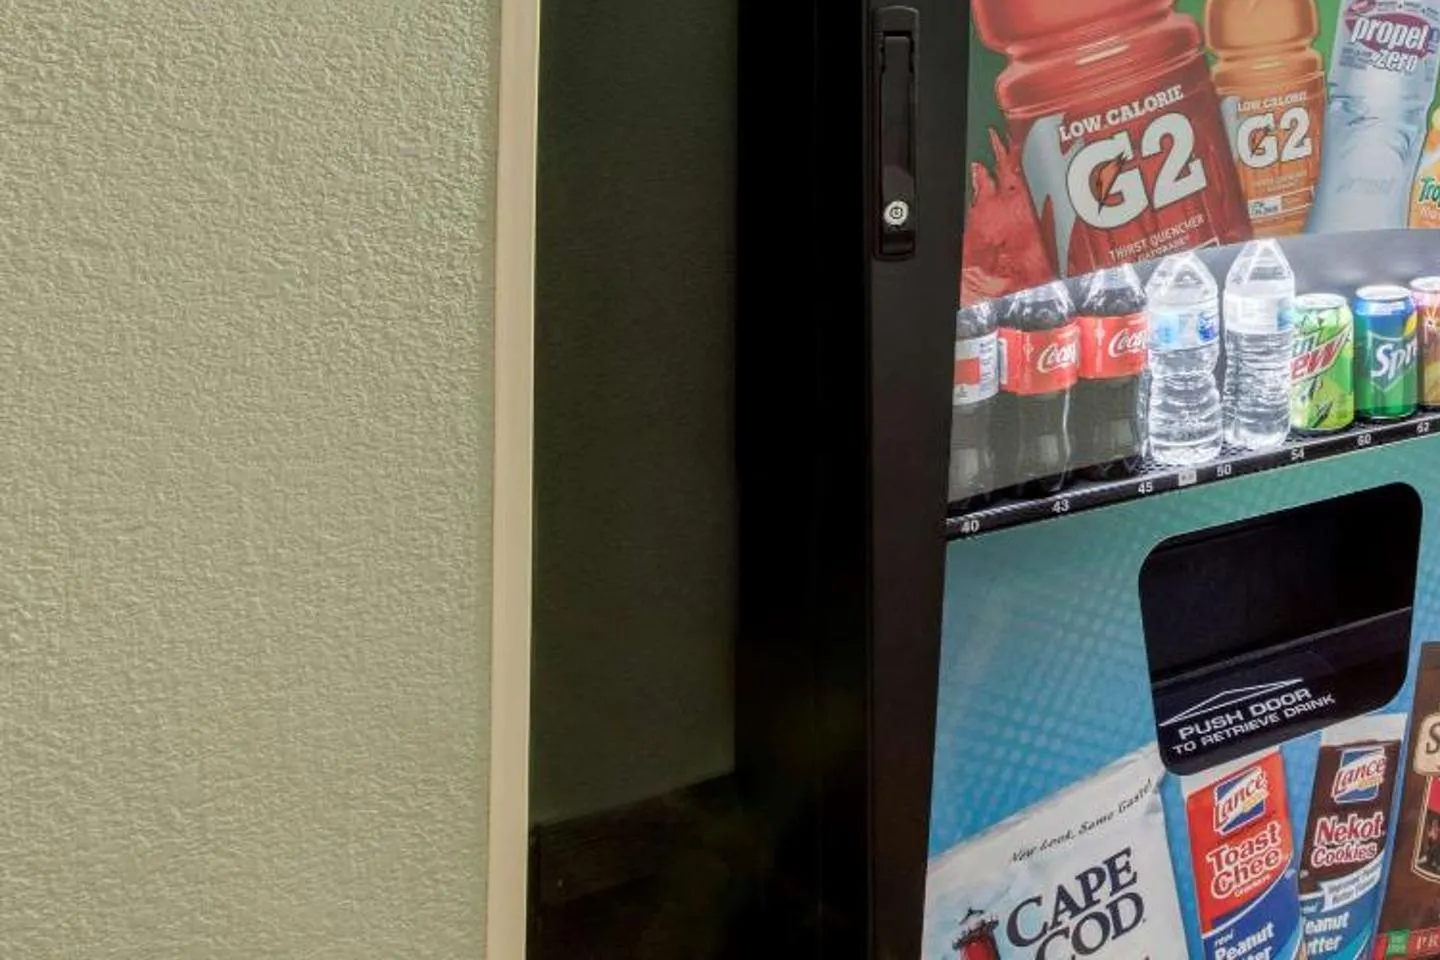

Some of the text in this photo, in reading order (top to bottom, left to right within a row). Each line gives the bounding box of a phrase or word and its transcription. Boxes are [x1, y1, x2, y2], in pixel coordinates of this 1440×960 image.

[1351, 16, 1429, 51] propel
[1375, 50, 1418, 73] zero
[1059, 84, 1184, 142] LOW CALORIE
[1238, 107, 1313, 168] G2
[1067, 112, 1207, 229] G2
[1138, 480, 1153, 494] 45
[1217, 463, 1232, 477] 50
[1052, 499, 1070, 514] 43
[1173, 693, 1336, 754] TO RETRIEVE DRINK
[1178, 688, 1312, 740] PUSH DOOR
[1214, 771, 1267, 831] Lance
[1332, 757, 1387, 798] Lance
[1011, 844, 1037, 863] New
[1078, 813, 1114, 836] Same
[1207, 821, 1281, 875] Toast
[1315, 811, 1385, 845] Nekot
[1211, 848, 1281, 899] Chee
[1311, 842, 1377, 868] Cookies
[1006, 846, 1138, 947] CAPE
[1035, 892, 1144, 960] COD
[1215, 922, 1275, 960] Peanut
[1302, 912, 1349, 935] eanut
